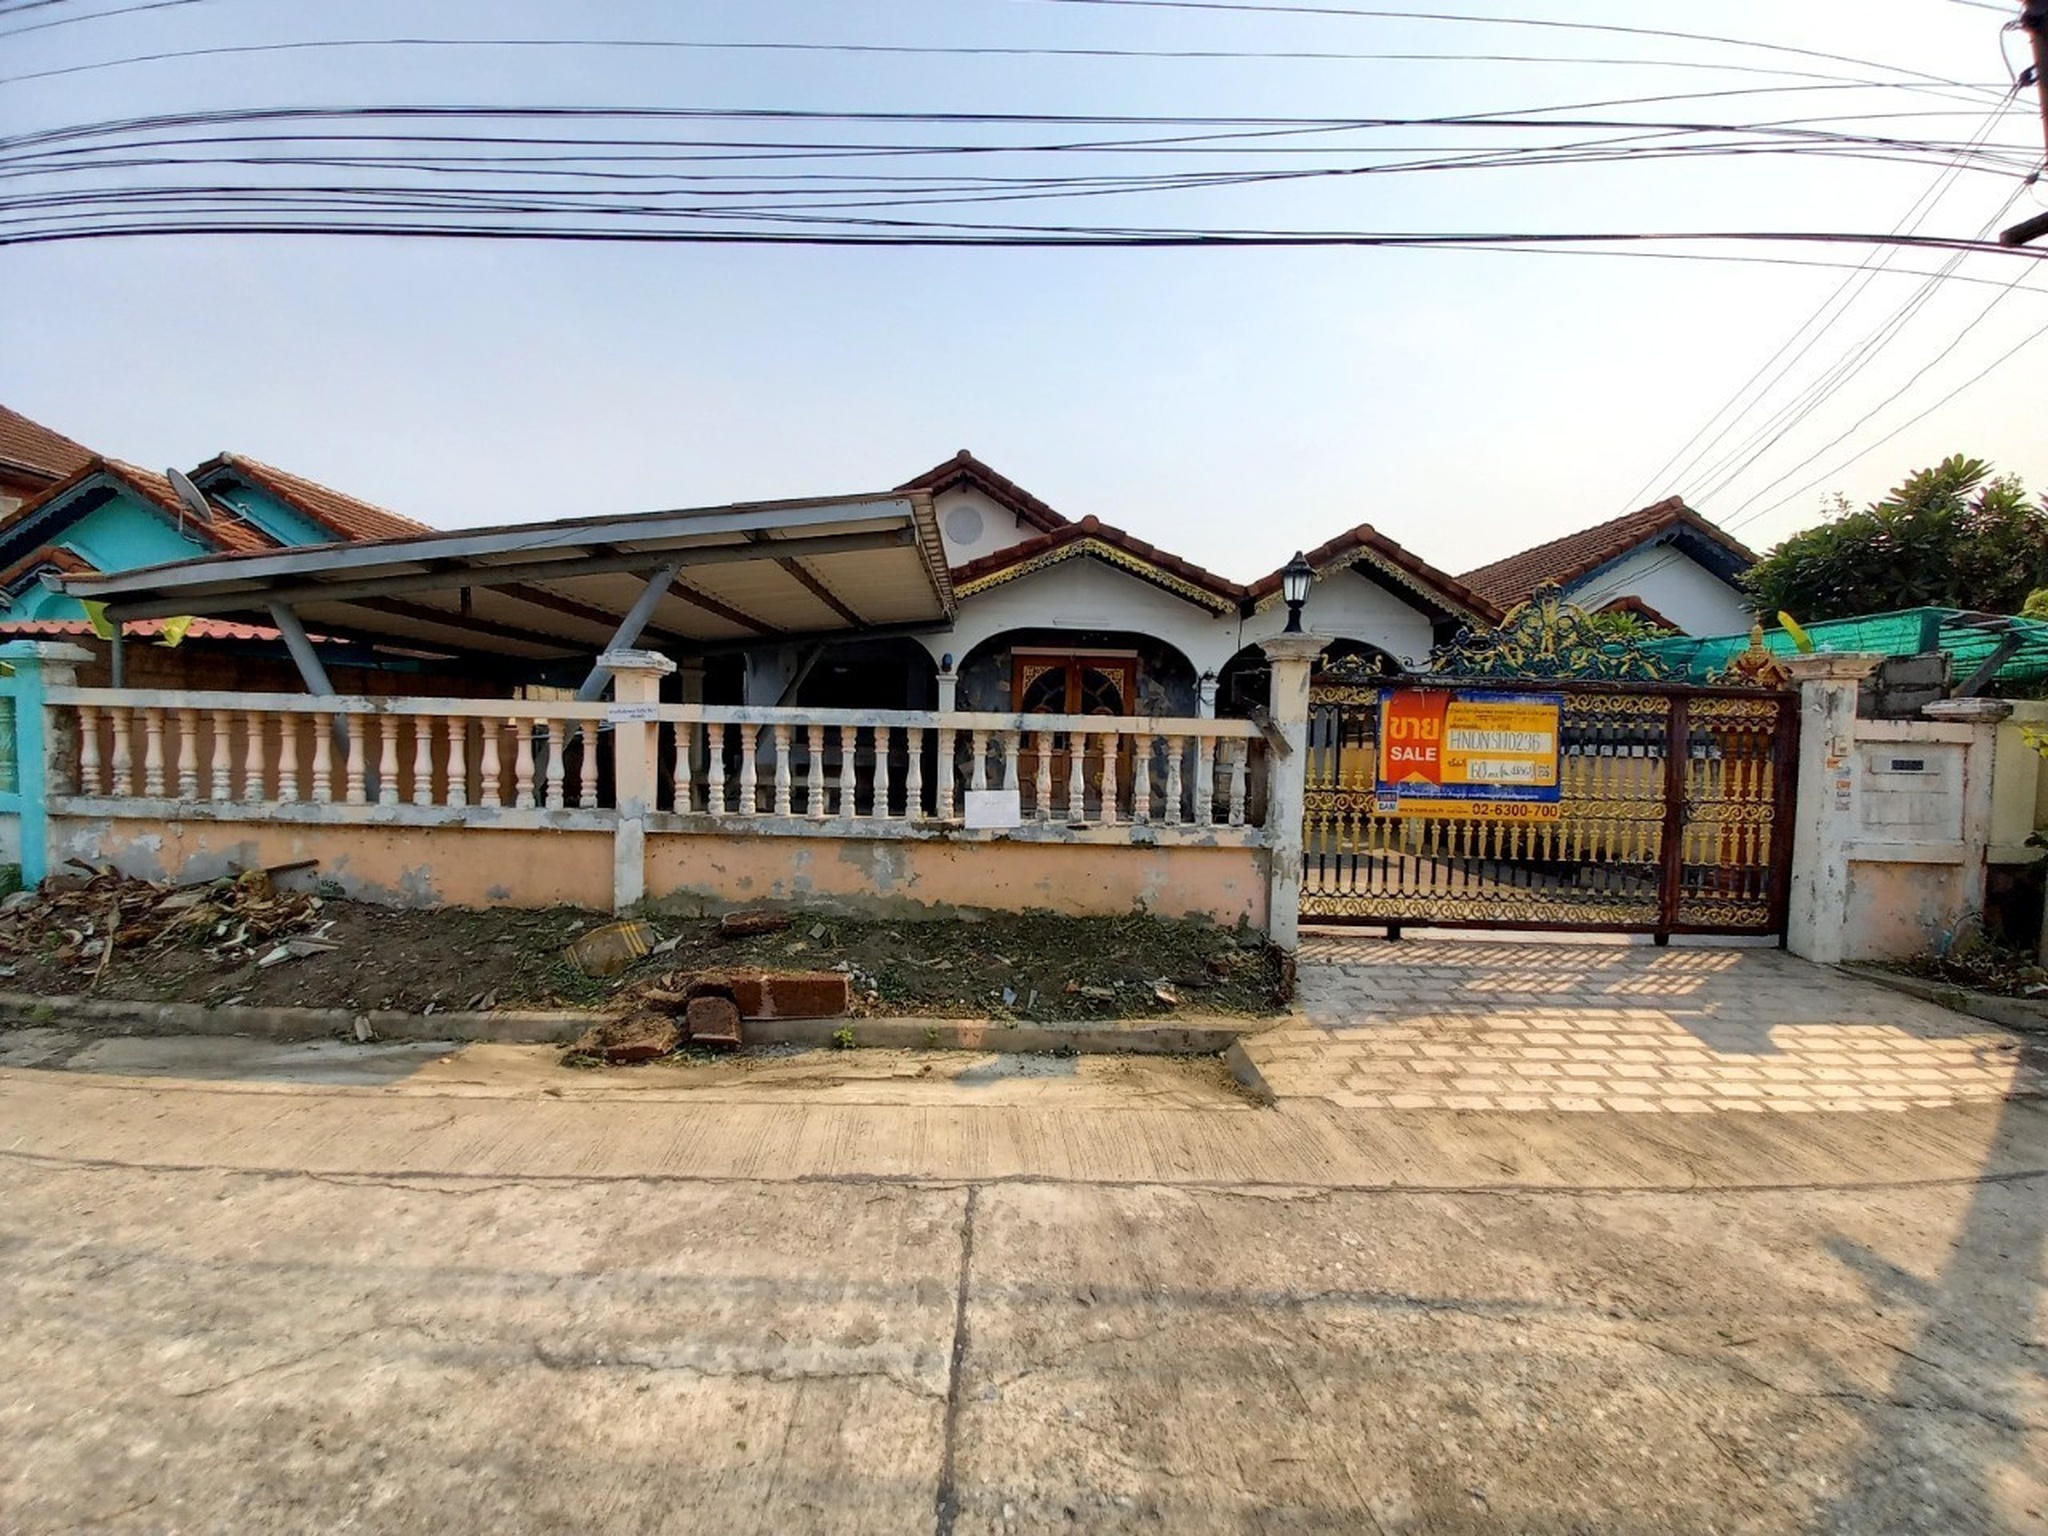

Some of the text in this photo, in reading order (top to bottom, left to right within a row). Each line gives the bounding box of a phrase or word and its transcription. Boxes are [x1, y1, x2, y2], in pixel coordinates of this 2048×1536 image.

[1390, 716, 1439, 740] ขาย
[1390, 746, 1437, 761] SALE
[1472, 803, 1558, 817] 02-6300-700
